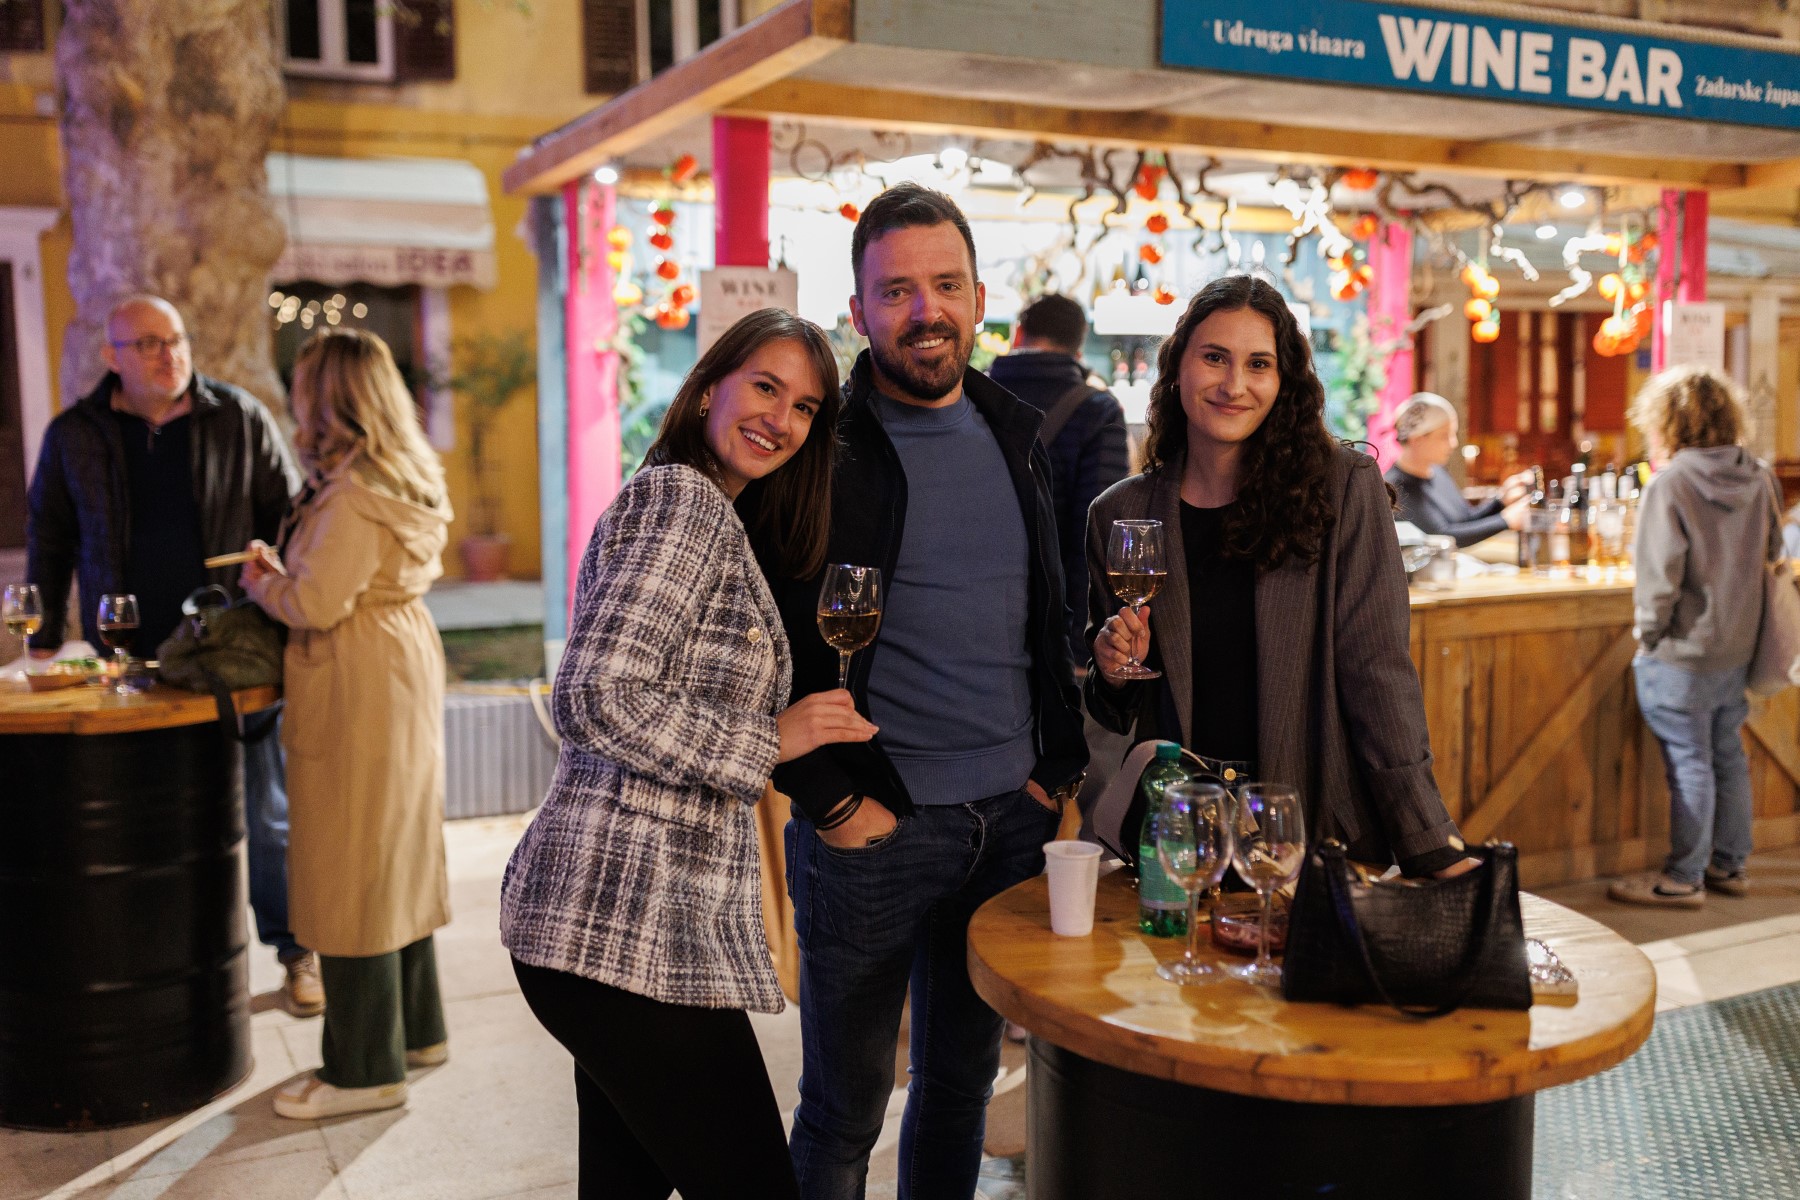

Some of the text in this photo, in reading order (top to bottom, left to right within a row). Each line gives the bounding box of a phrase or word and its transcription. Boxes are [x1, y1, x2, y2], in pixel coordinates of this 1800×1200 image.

[1213, 19, 1366, 60] Udruga vinara
[1378, 14, 1684, 109] WINE BAR
